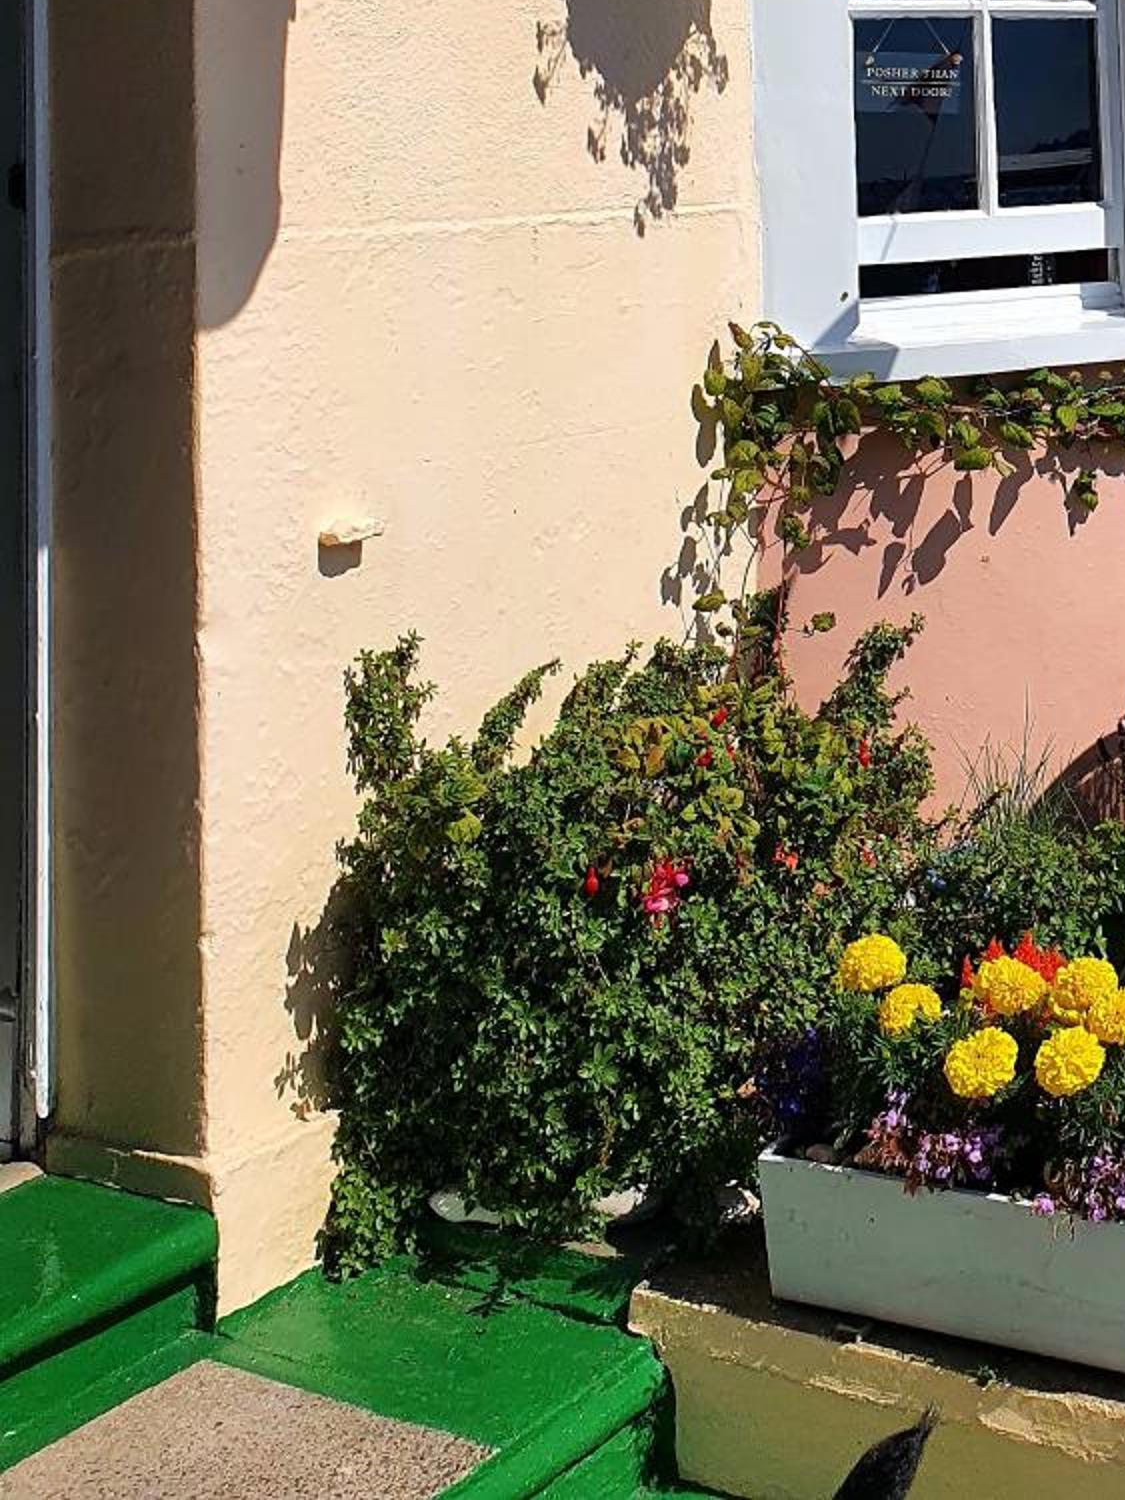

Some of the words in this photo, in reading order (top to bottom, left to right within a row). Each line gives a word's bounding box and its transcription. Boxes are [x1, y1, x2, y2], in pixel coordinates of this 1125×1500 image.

[866, 67, 919, 79] POSHER
[922, 68, 959, 80] THAN
[871, 85, 906, 97] NEXT
